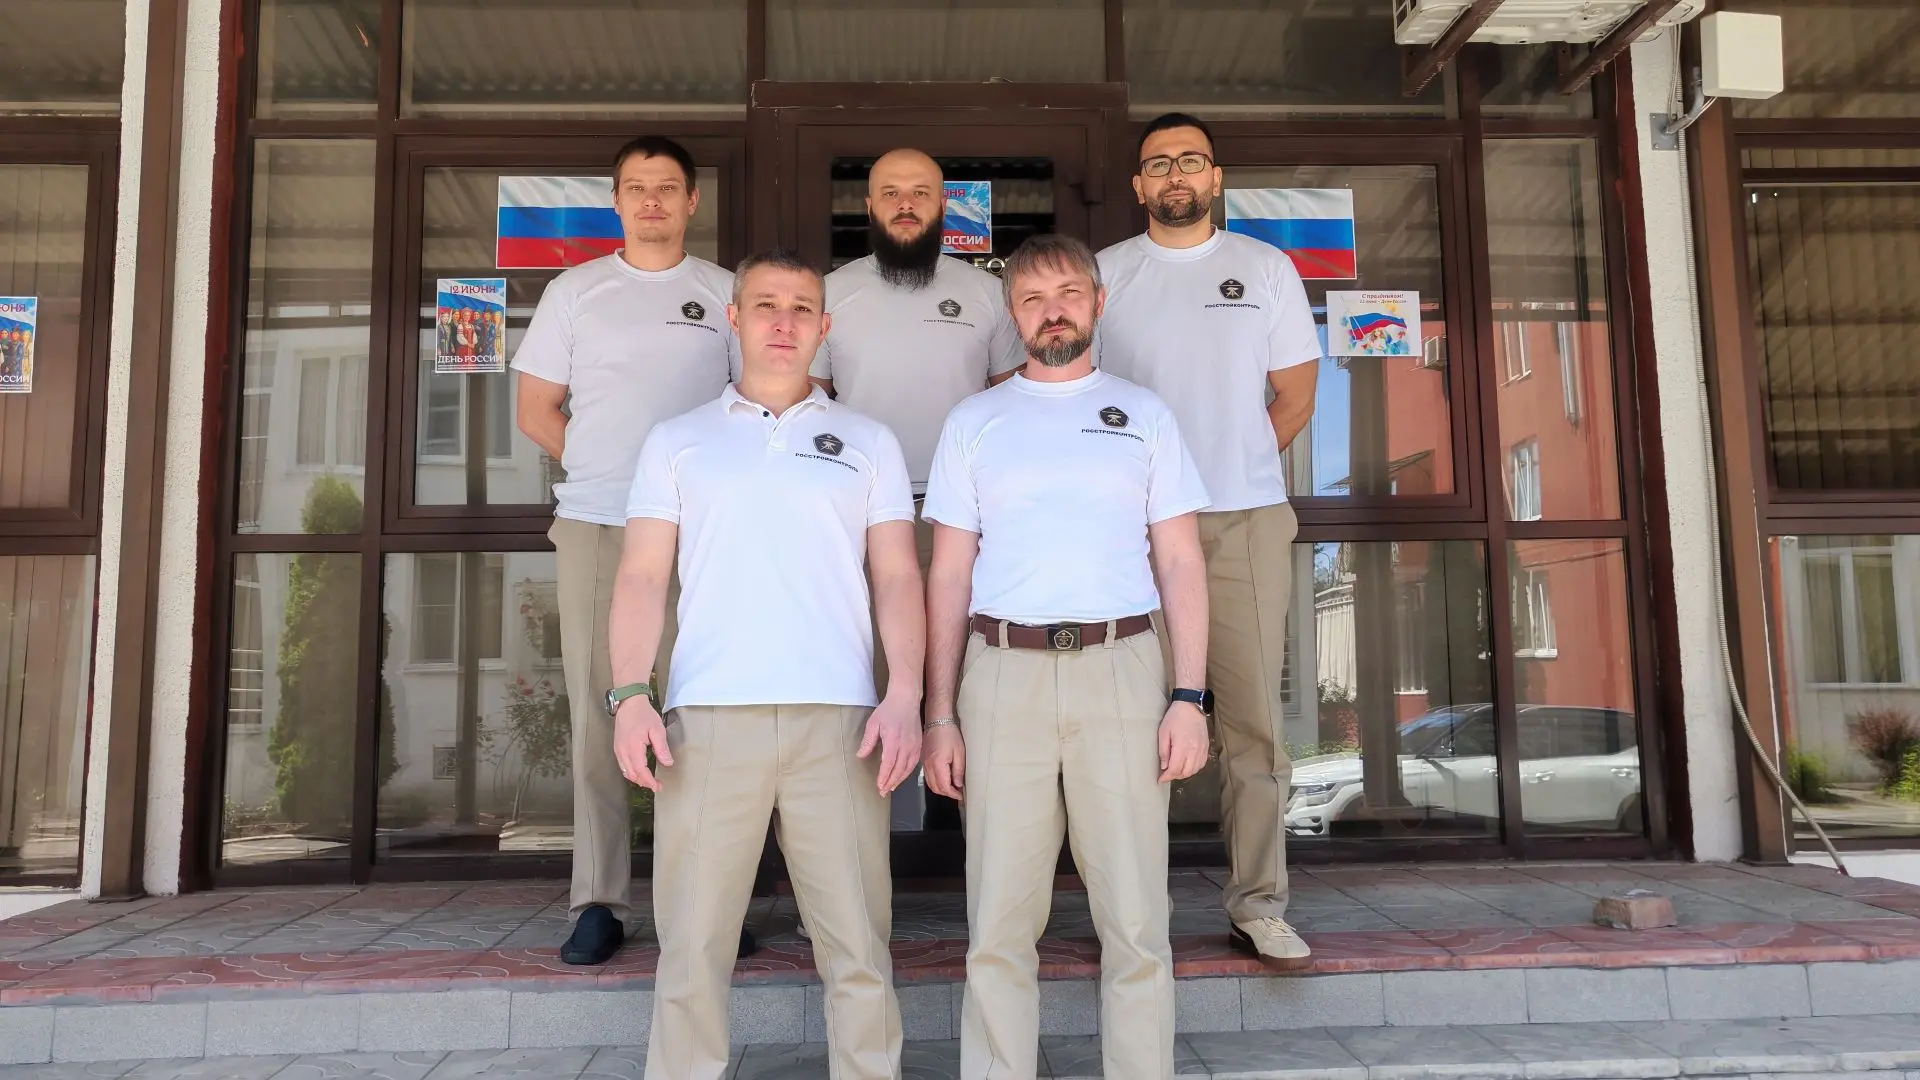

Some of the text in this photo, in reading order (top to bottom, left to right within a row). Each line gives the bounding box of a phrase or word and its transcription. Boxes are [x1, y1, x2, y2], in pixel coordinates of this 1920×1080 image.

[943, 235, 984, 245] ОССИИ
[450, 285, 497, 294] 12 ИЮНЯ
[0, 303, 26, 312] ЮНЯ
[437, 355, 503, 364] ДЕНЬ РОССИИ
[1081, 428, 1145, 443] РОССТРОЙКОНТРОЛЬ
[795, 452, 859, 473] РОССТРОЙКОНТРОЛЬ
